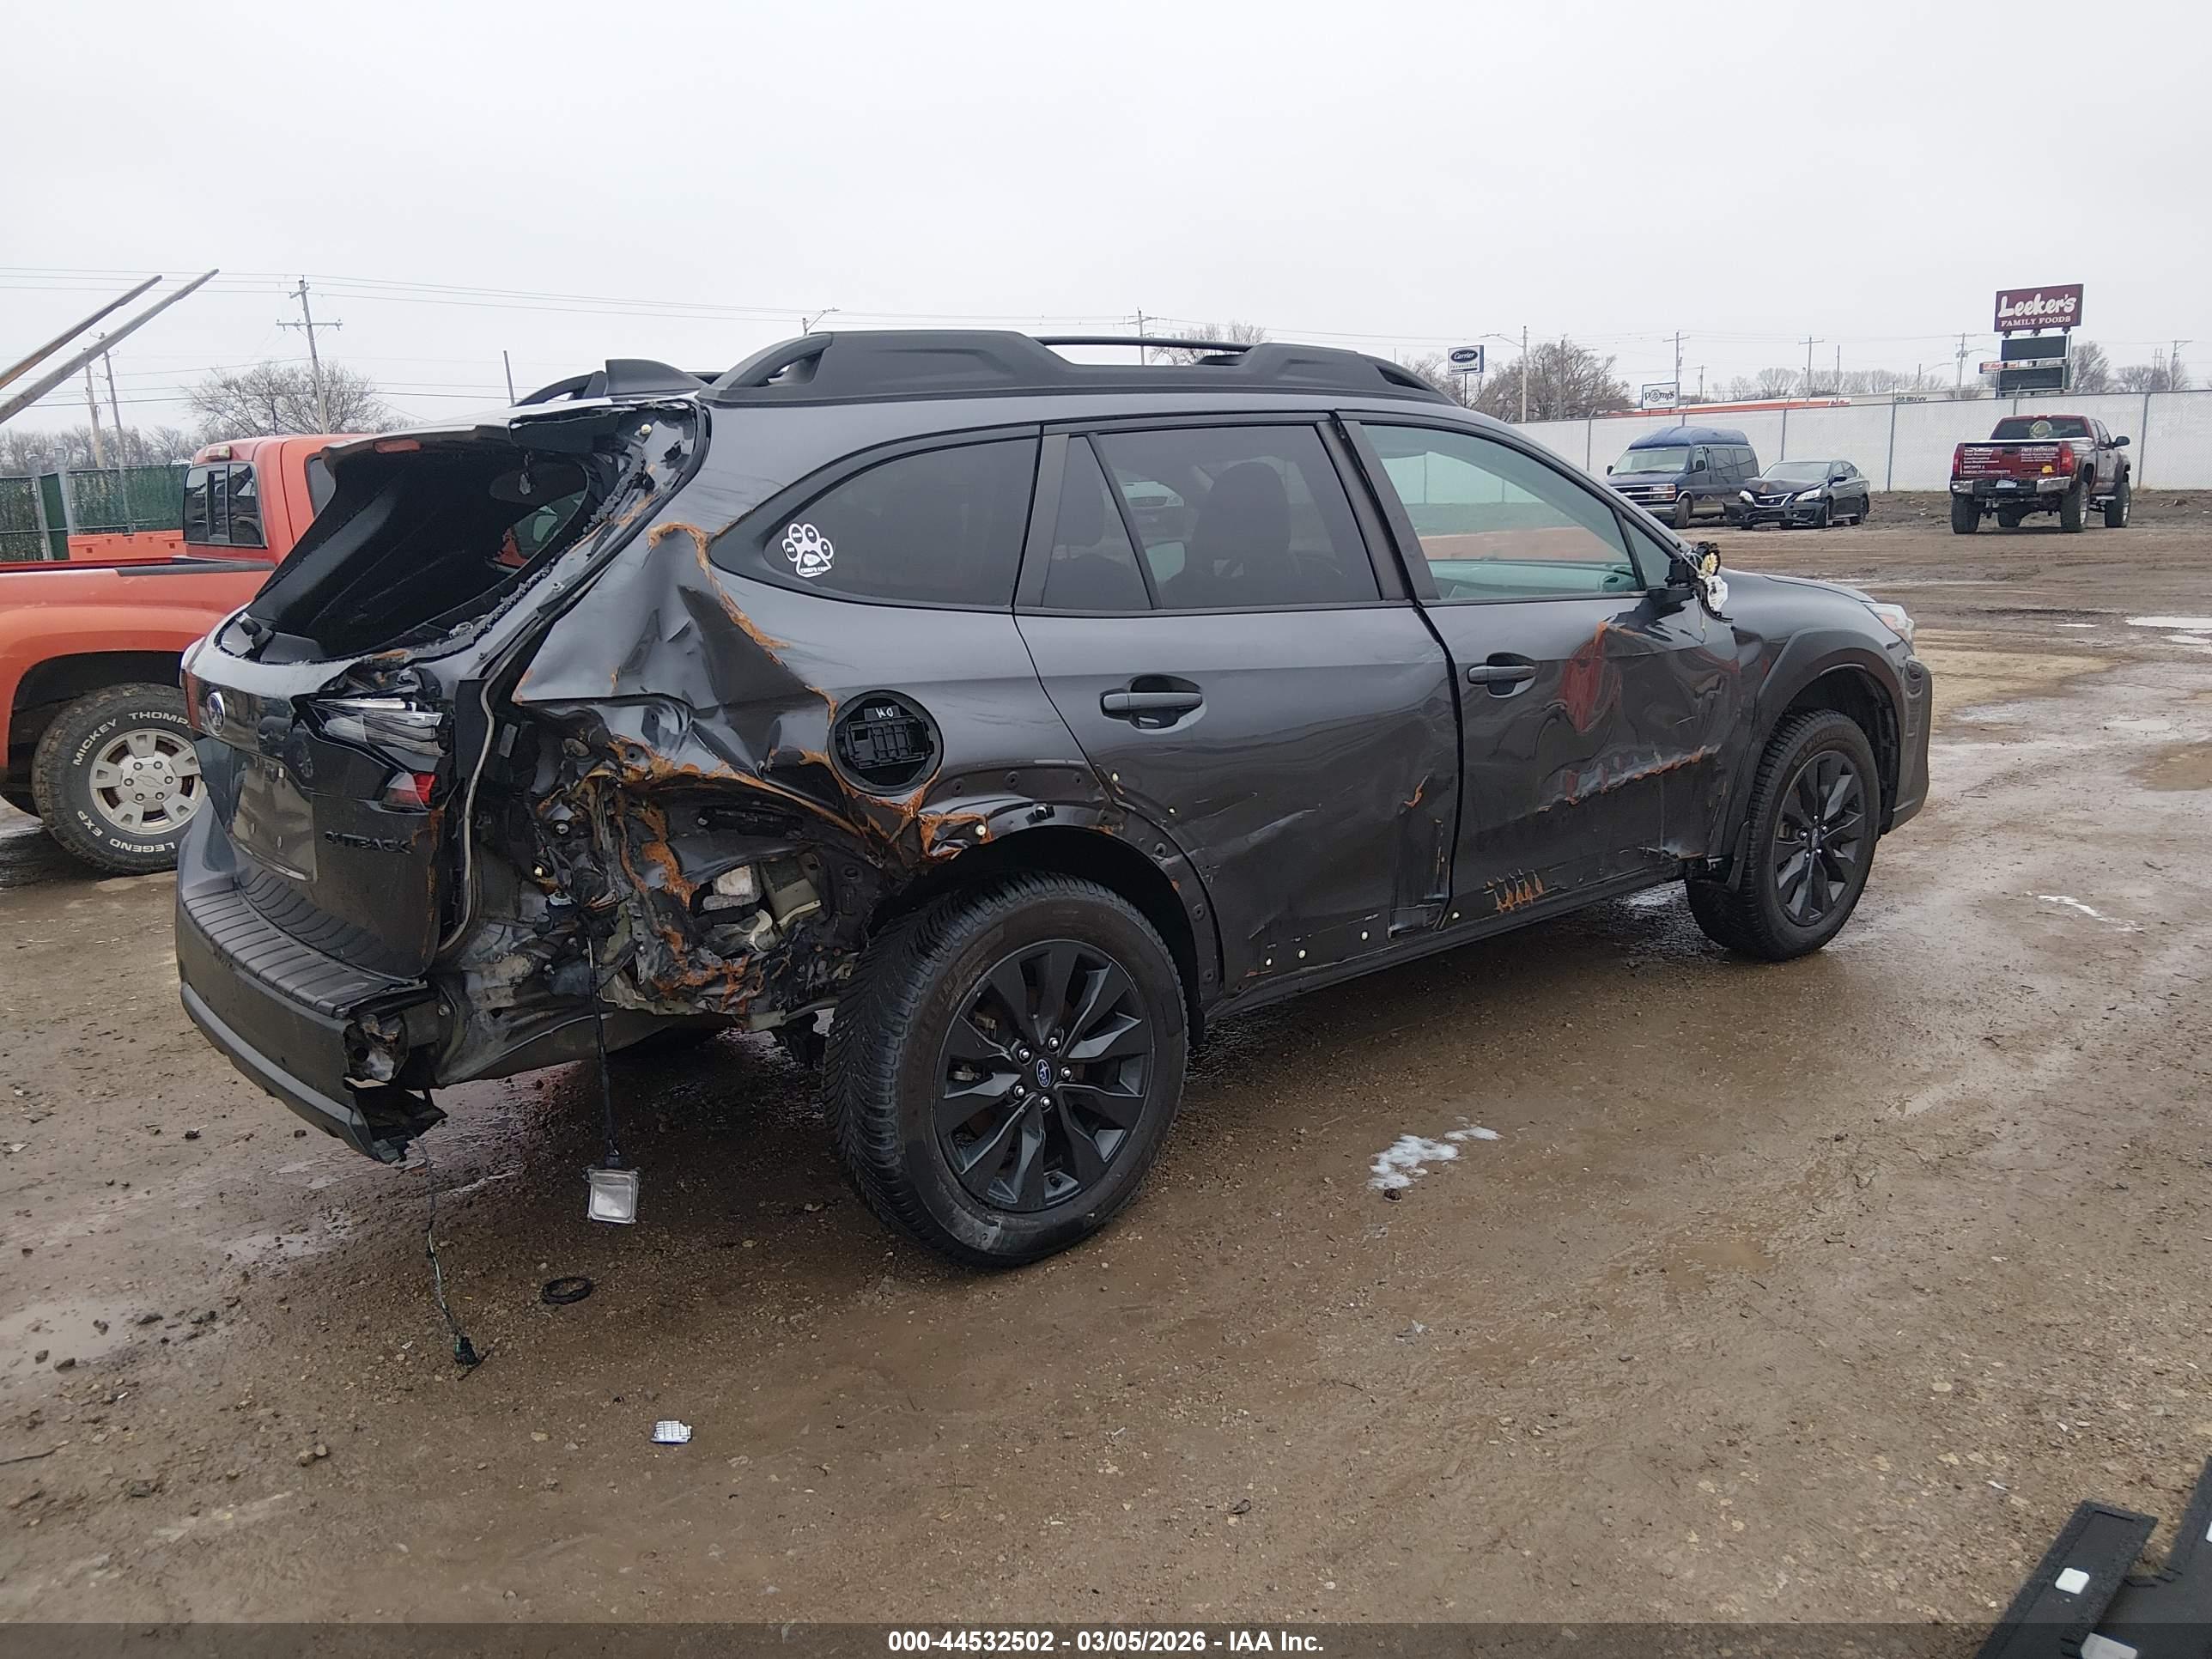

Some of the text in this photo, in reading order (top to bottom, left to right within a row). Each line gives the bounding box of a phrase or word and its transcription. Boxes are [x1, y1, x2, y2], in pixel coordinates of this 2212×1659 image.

[1998, 292, 2077, 319] Leeker's
[2001, 315, 2071, 327] FAMILY FOODS
[1453, 351, 1475, 360] Carrier
[72, 718, 118, 767] MICKEY
[76, 810, 177, 854] LEGEND EXP
